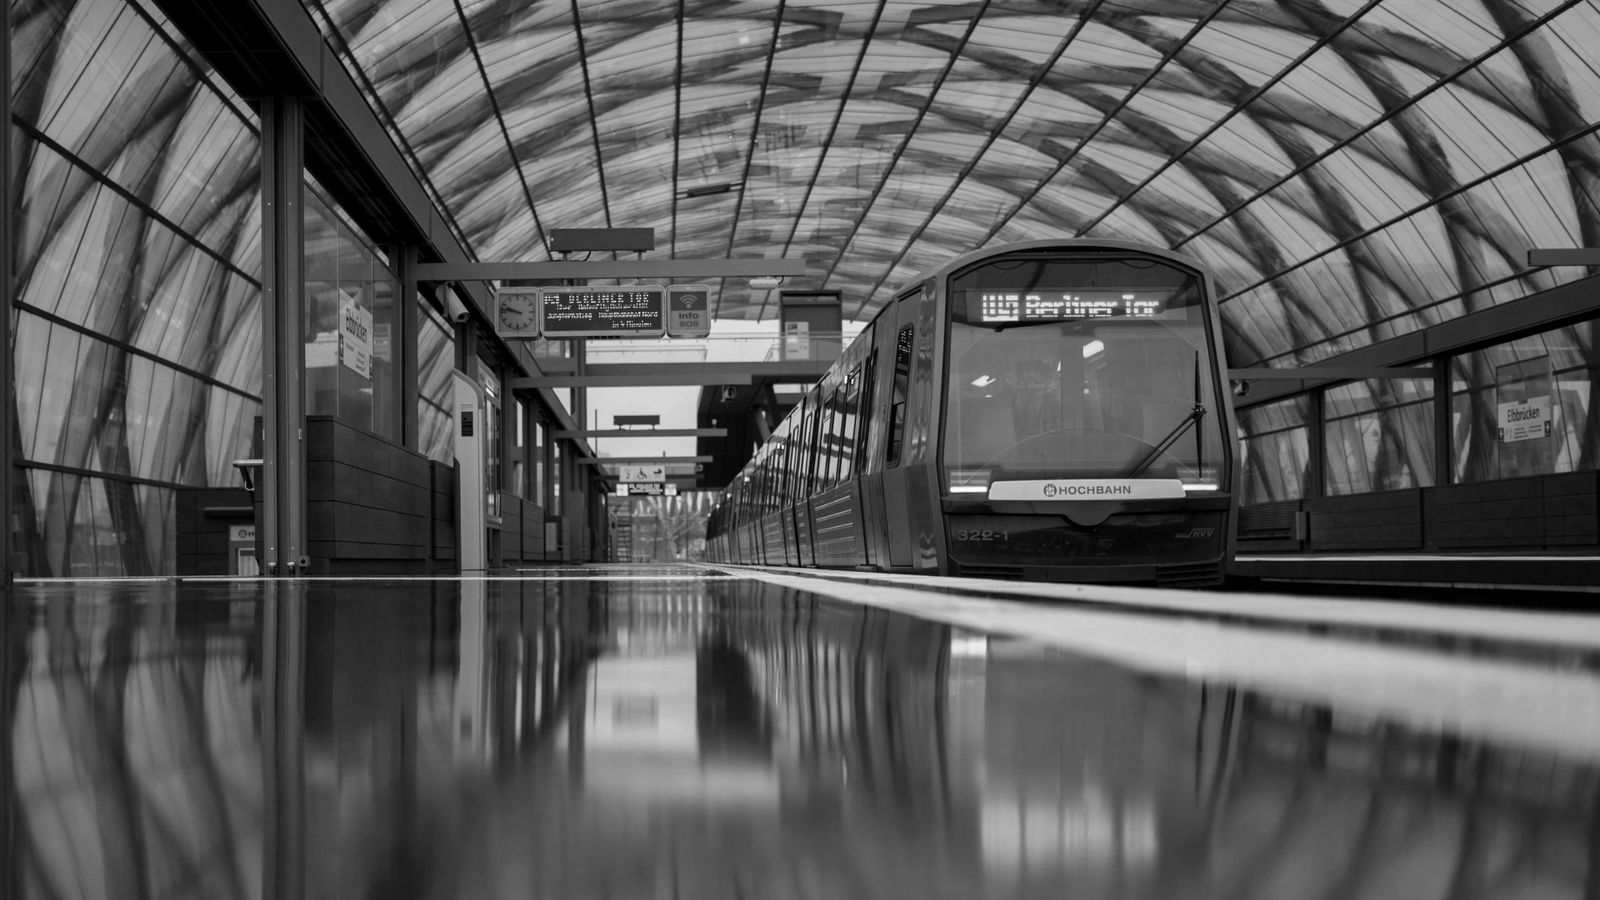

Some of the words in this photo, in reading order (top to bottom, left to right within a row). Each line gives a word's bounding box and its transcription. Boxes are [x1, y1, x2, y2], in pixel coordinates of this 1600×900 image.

[568, 293, 624, 303] BERLINER
[629, 292, 649, 302] TOR
[983, 294, 1018, 320] U4
[1026, 294, 1118, 318] Berliner
[1122, 294, 1160, 317] Tor
[679, 312, 700, 320] Info
[345, 307, 368, 344] Elbbrücken
[679, 320, 700, 328] SOS
[1507, 405, 1540, 423] Elbbrücken
[1058, 484, 1132, 496] HOCHBAHN
[957, 529, 1009, 541] 322-1
[1191, 528, 1214, 538] HVV
